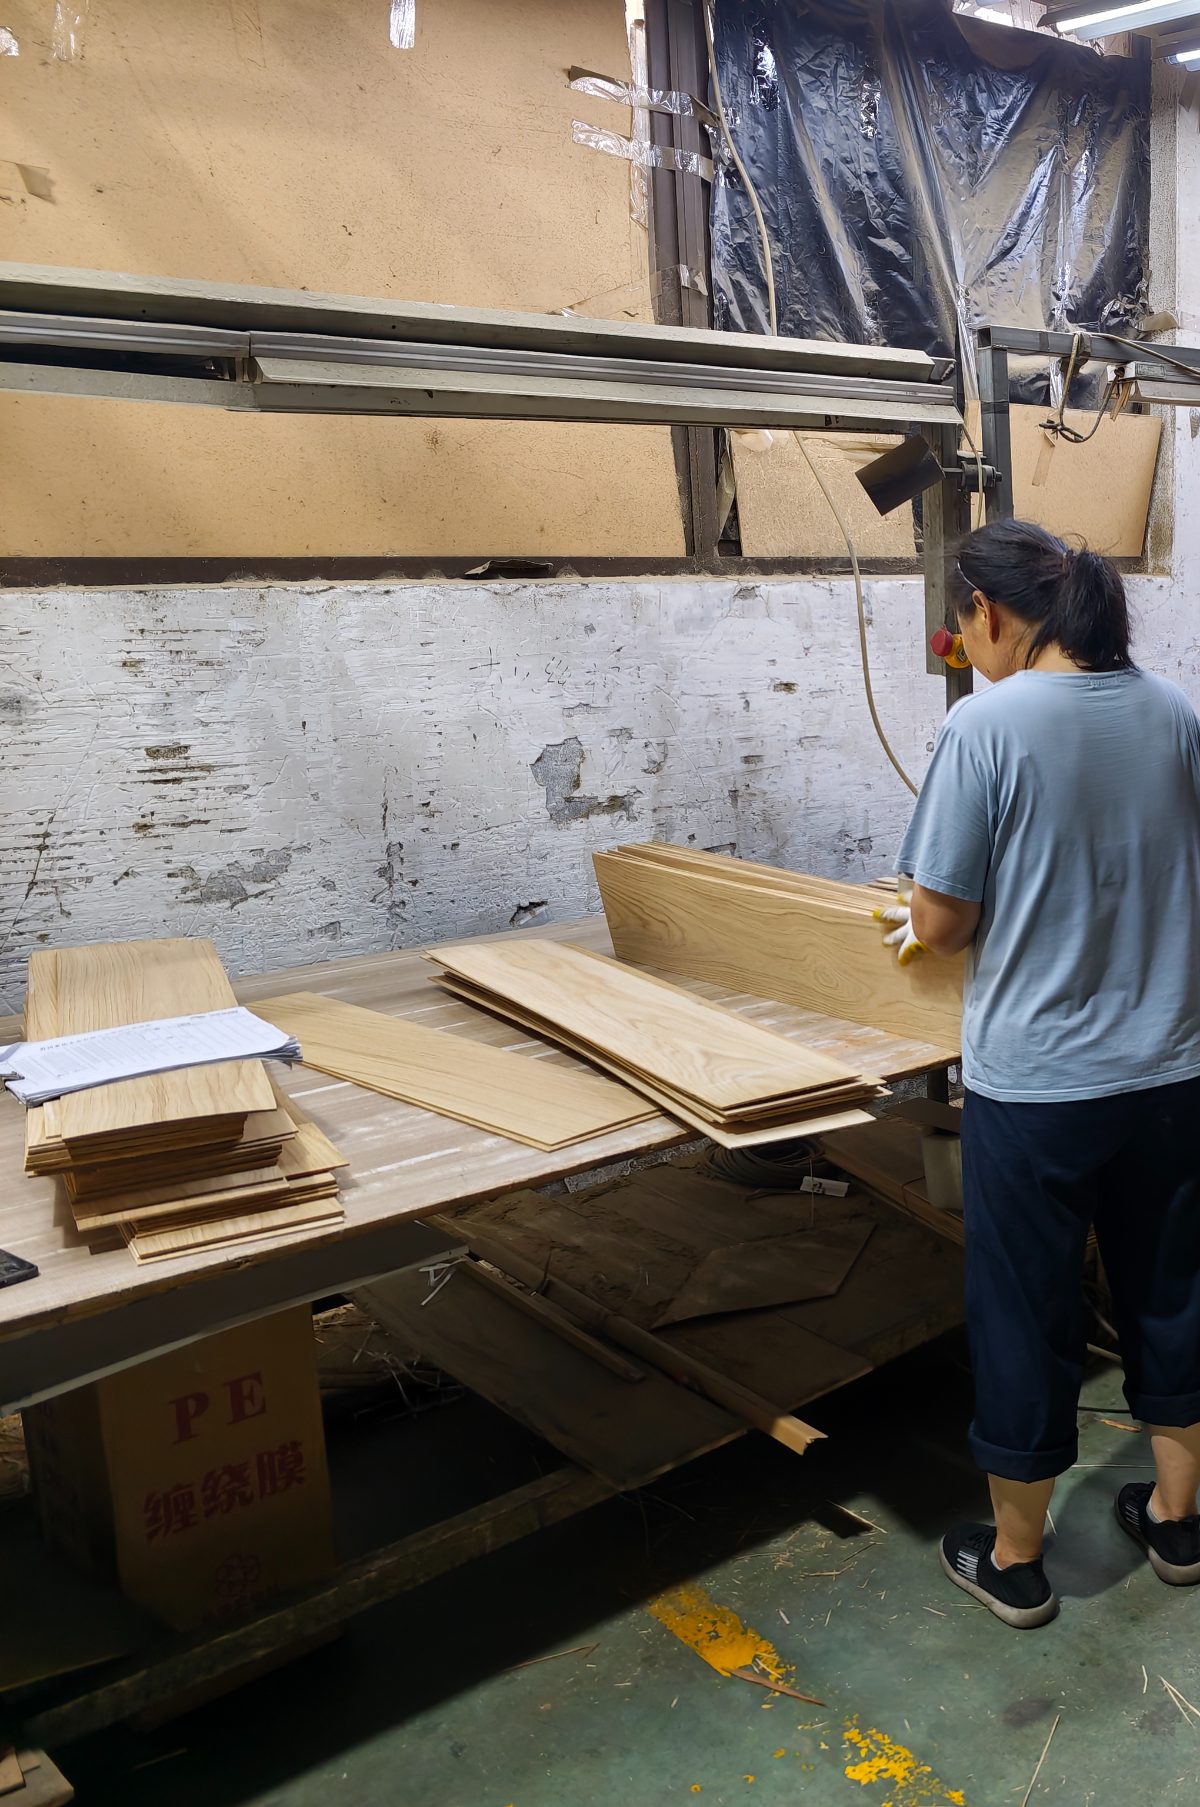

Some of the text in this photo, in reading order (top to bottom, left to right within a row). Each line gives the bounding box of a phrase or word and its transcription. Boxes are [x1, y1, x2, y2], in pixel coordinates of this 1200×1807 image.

[168, 1371, 267, 1445] PE
[142, 1440, 306, 1540] 缠绕膜
